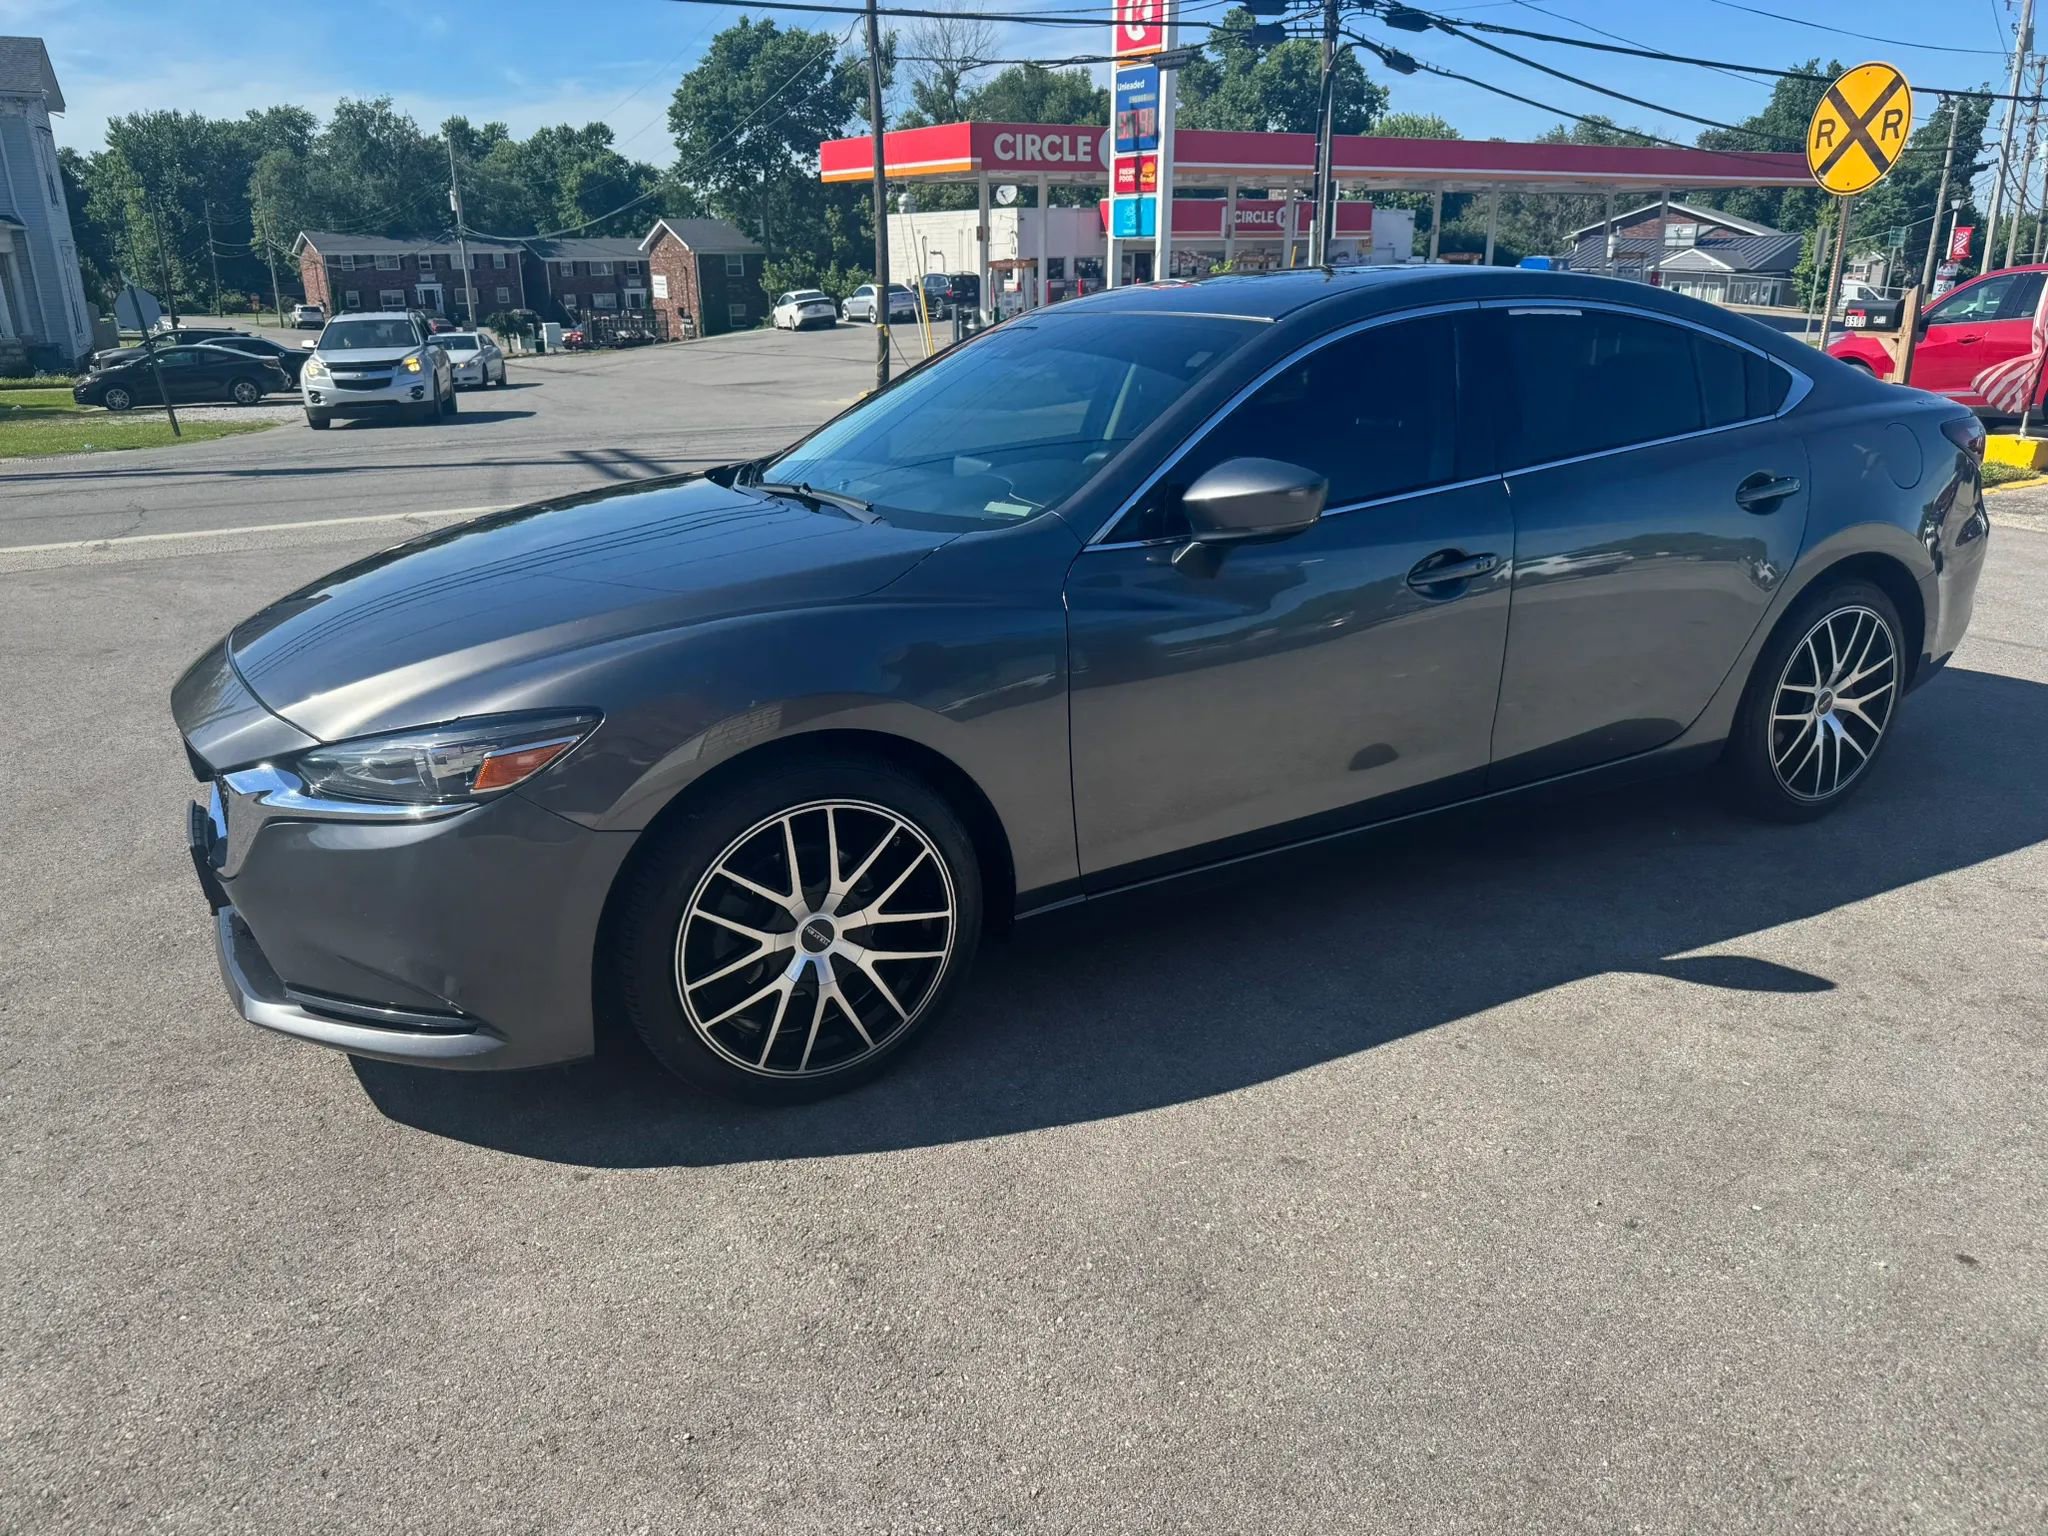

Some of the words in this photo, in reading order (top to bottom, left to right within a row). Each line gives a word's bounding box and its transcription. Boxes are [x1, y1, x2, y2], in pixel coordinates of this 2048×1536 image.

[1118, 79, 1145, 91] Unleaded
[1815, 118, 1836, 149] R
[1881, 109, 1903, 141] R
[993, 133, 1092, 162] CIRCLE
[1234, 210, 1275, 224] CIRCLE
